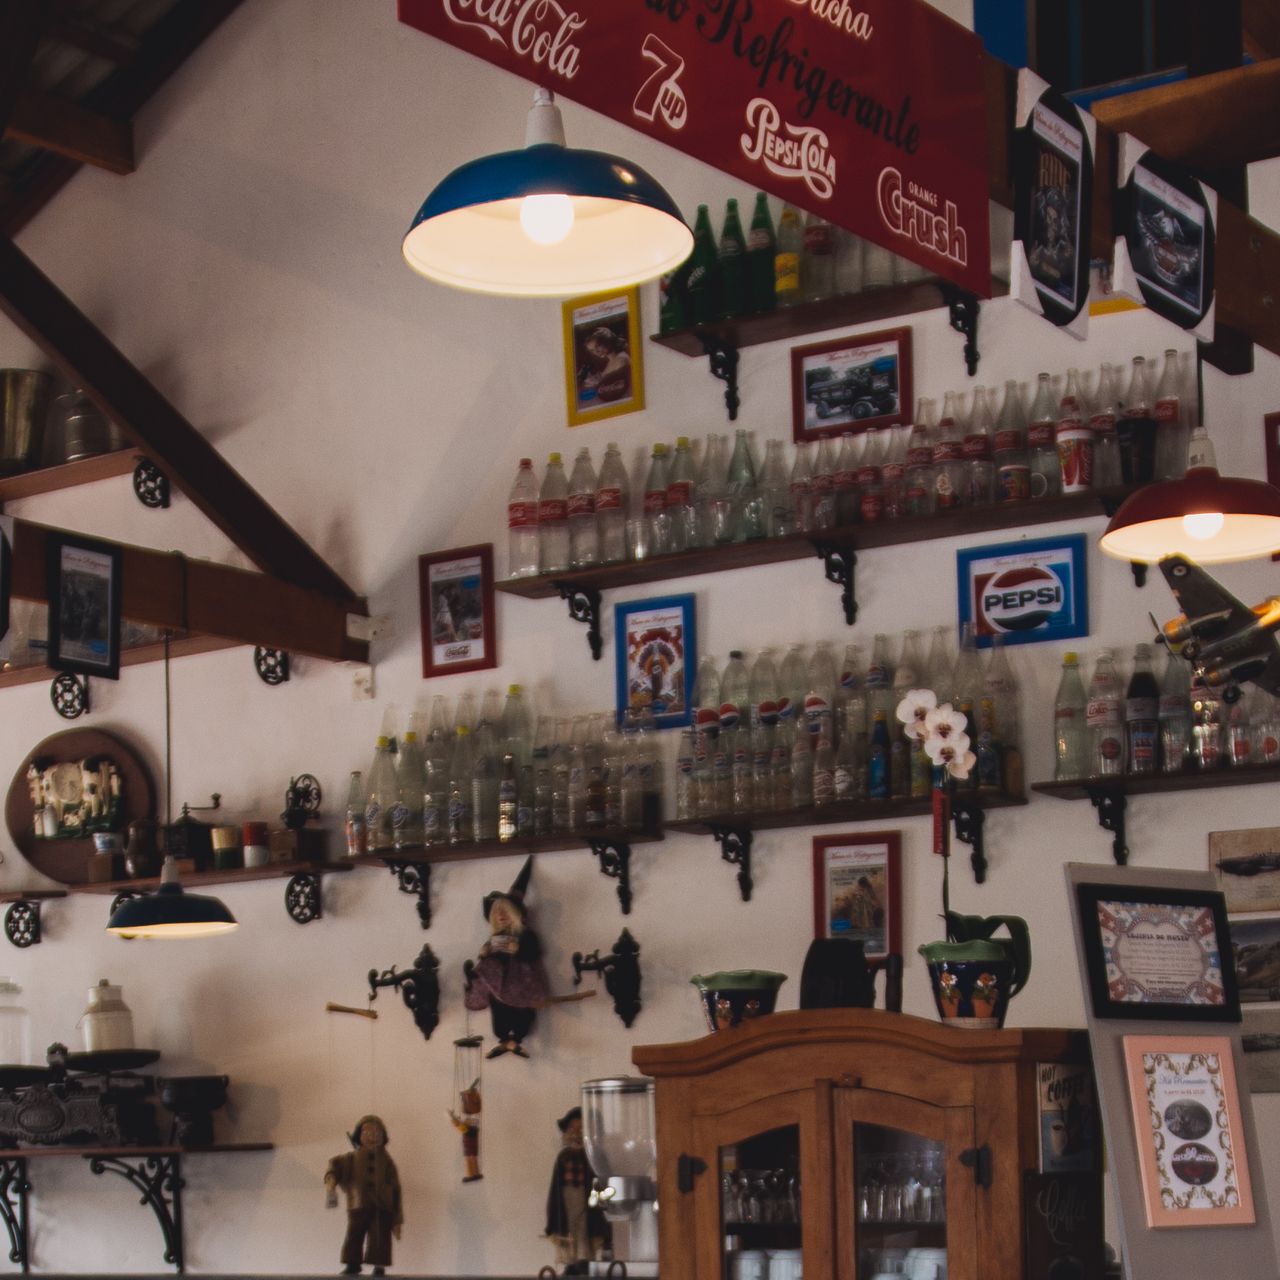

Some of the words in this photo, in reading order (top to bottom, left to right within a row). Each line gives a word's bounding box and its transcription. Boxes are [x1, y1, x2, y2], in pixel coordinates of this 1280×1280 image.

[908, 181, 940, 207] ORANGE
[877, 166, 968, 266] Crush
[984, 586, 1061, 612] PEPSI
